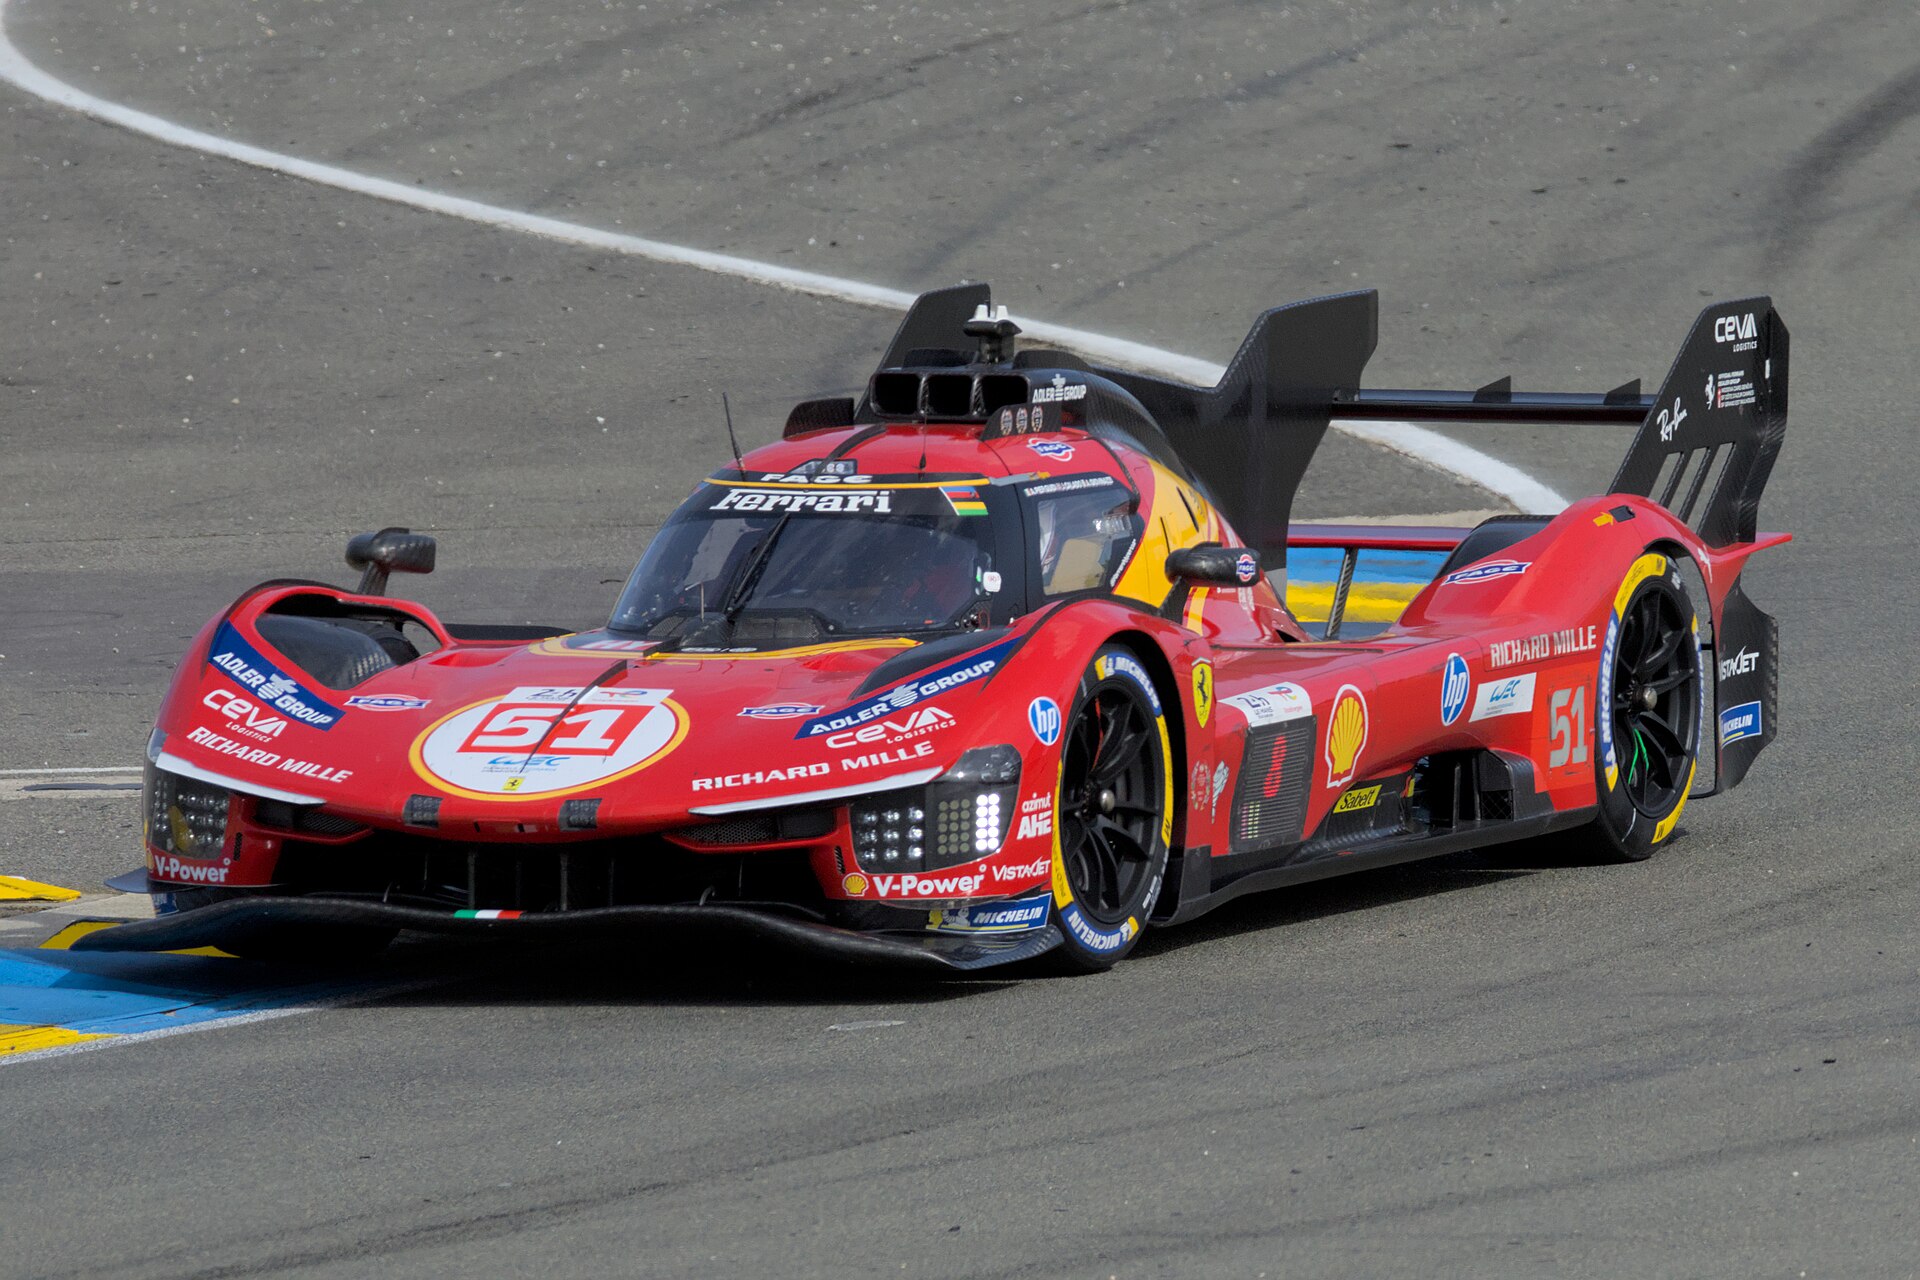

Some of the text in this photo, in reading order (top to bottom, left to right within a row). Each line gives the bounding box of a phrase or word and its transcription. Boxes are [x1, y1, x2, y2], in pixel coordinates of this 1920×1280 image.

[1733, 341, 1757, 352] LOGISTICS
[1032, 384, 1087, 403] ADLER GROUP
[709, 488, 892, 513] Ferrari
[1490, 625, 1597, 668] RICHARD MILLE
[212, 652, 333, 725] ADLER GROUP
[809, 660, 997, 735] ADLER GROUP
[1114, 656, 1160, 709] MICHELIN
[1443, 658, 1467, 723] hp
[1602, 619, 1618, 743] MICHELIN
[225, 721, 273, 743] LOGISTICS
[471, 708, 626, 749] 51
[886, 719, 957, 744] LOGISTICS
[1036, 702, 1058, 744] hp
[1550, 686, 1588, 769] 51
[186, 726, 354, 783] RICHARD MILLE
[691, 741, 935, 791] RICHARD MILLE
[1021, 792, 1052, 812] azimut
[1340, 788, 1375, 810] Sabelt
[154, 855, 230, 883] V-Power
[872, 871, 985, 897] V-Power
[992, 856, 1052, 881] VISTAJET
[974, 905, 1044, 925] MICHELIN
[1067, 910, 1121, 950] MICHELIN
